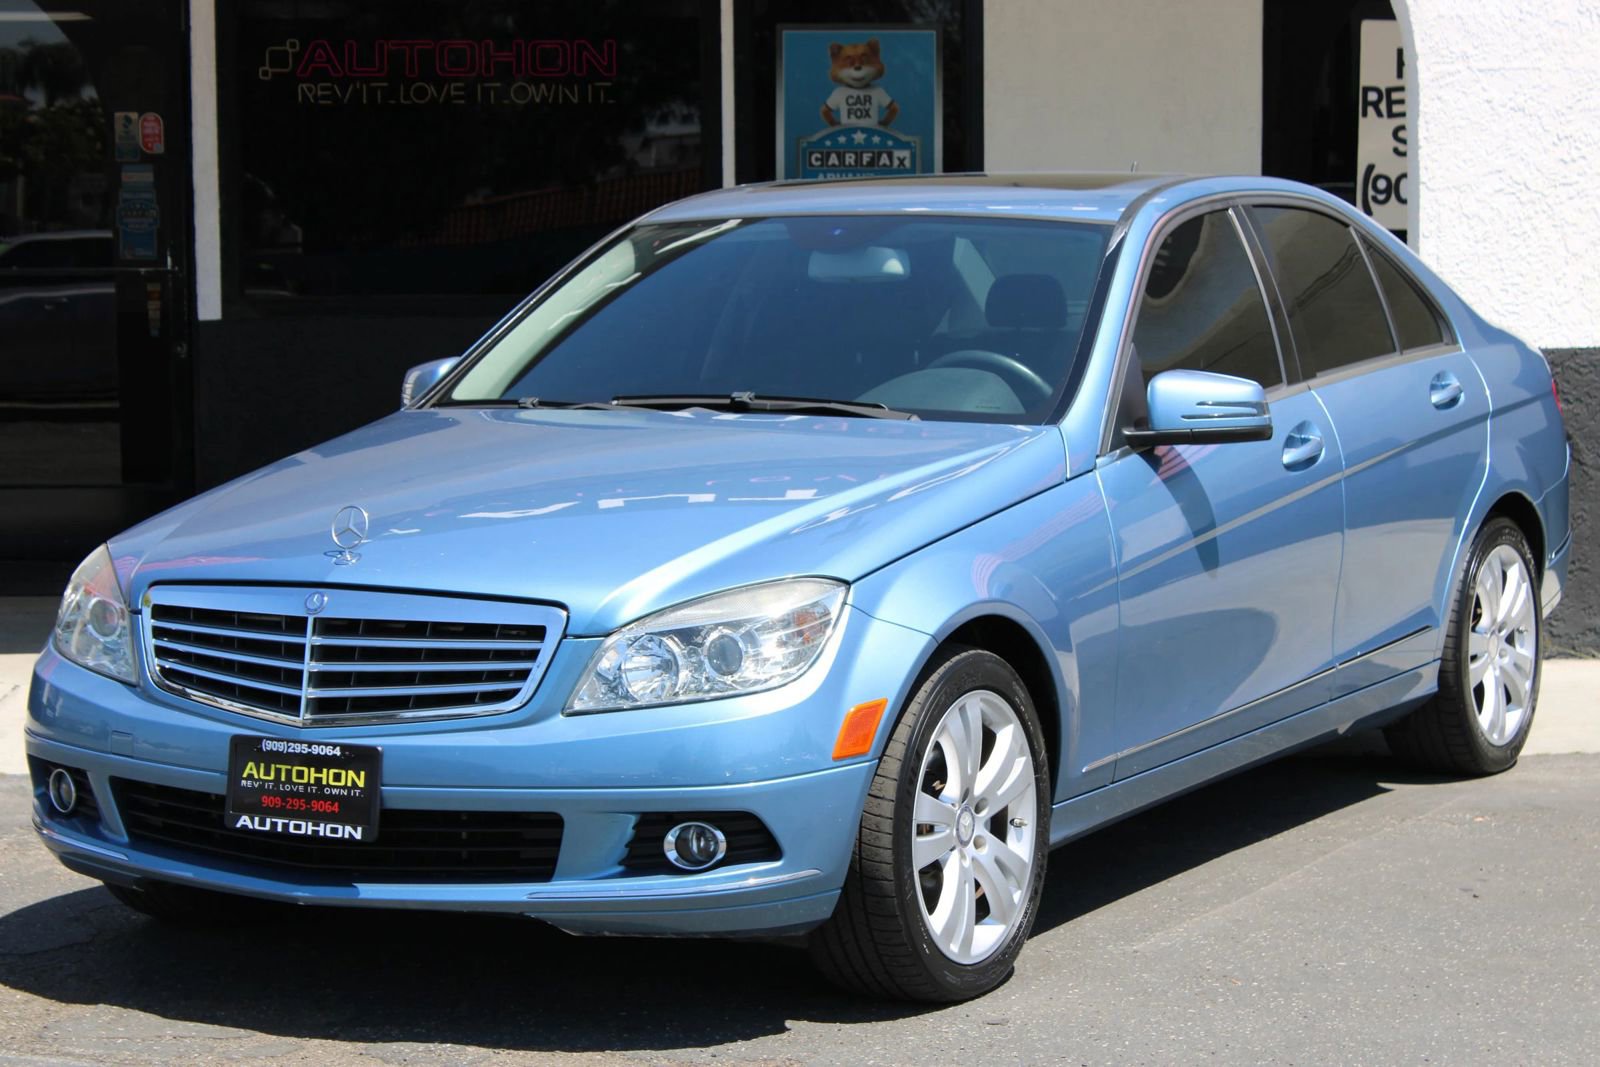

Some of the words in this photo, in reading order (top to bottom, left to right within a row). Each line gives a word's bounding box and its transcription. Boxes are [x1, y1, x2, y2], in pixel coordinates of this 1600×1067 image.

[296, 39, 616, 78] AUTOHON
[845, 94, 872, 107] CAR
[847, 107, 872, 119] FOX
[810, 152, 908, 168] CARFAX
[262, 739, 341, 756] (909)295-9064
[242, 761, 365, 788] AUTOHON
[279, 784, 305, 793] LOVE
[324, 787, 348, 796] OWN
[261, 795, 340, 814] 909-295-9064
[235, 815, 362, 840] AUTOHON
